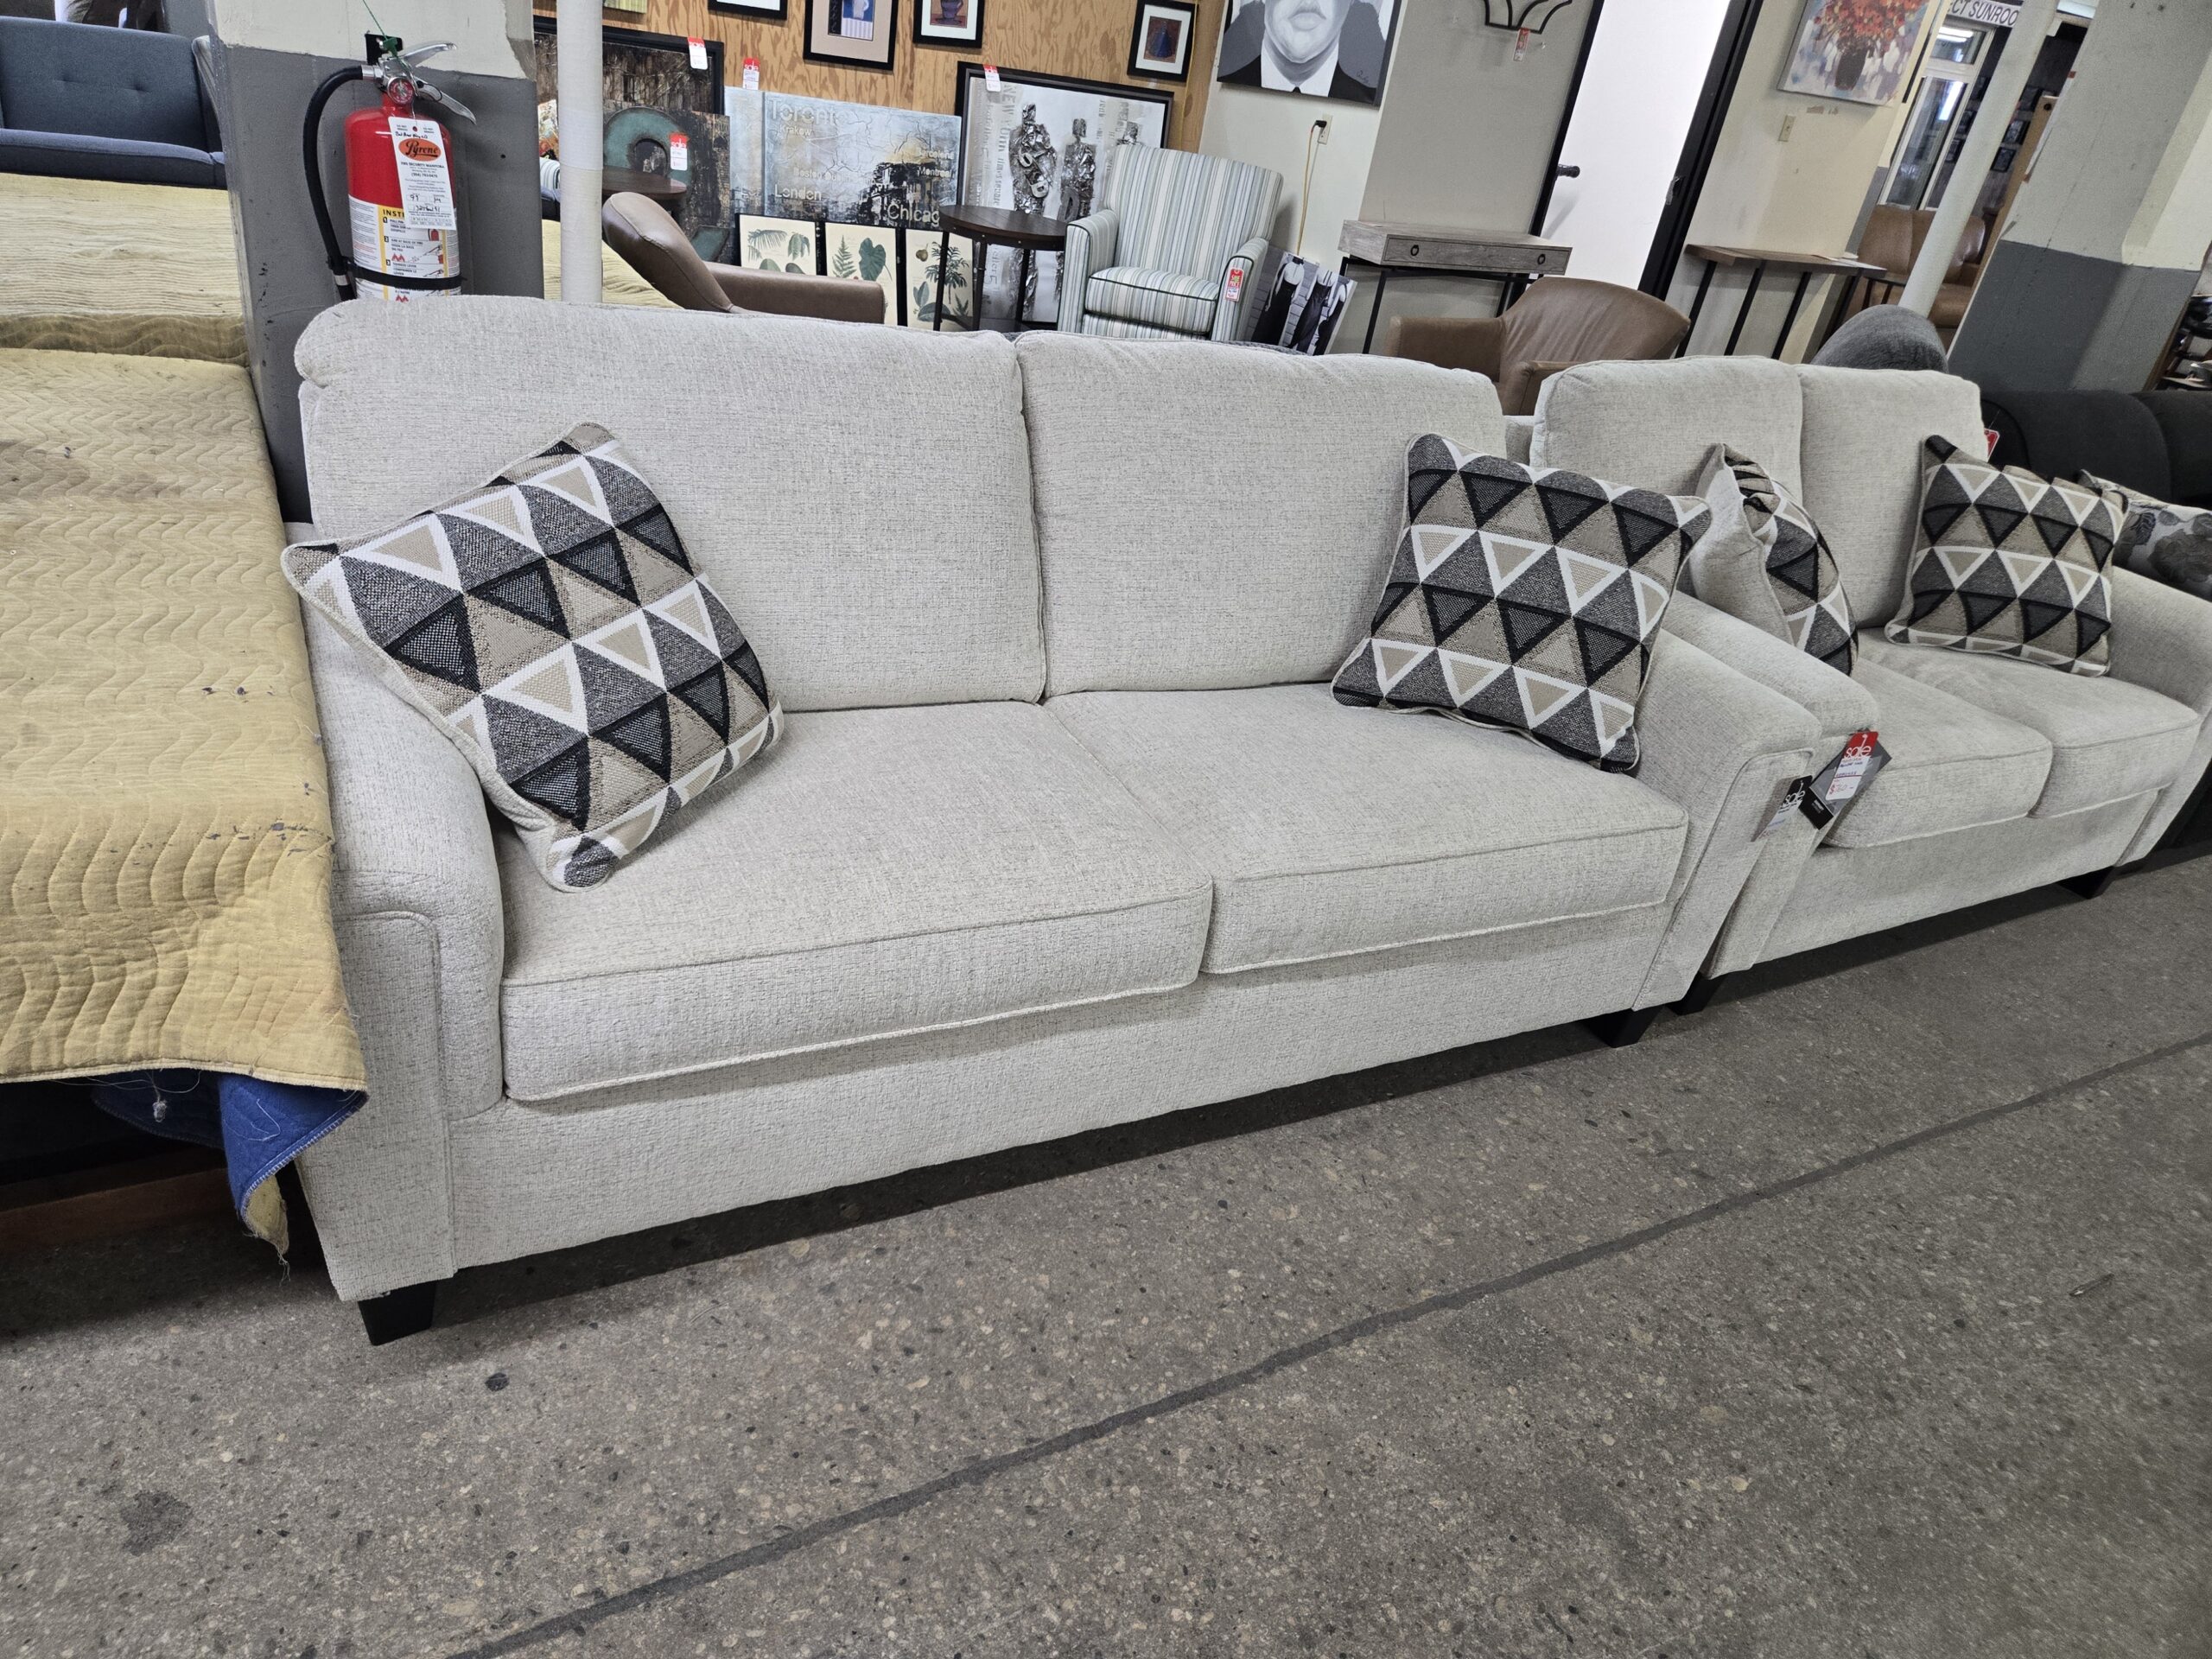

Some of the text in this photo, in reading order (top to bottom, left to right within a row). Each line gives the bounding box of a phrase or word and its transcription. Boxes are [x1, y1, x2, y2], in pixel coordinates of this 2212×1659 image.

[744, 60, 759, 71] sale
[779, 124, 812, 136] Krakow
[405, 140, 439, 158] Pyrene
[671, 137, 687, 149] sale
[775, 184, 822, 200] London
[887, 202, 940, 227] Chicag
[1844, 734, 1872, 759] sale
[1783, 781, 1806, 805] sale
